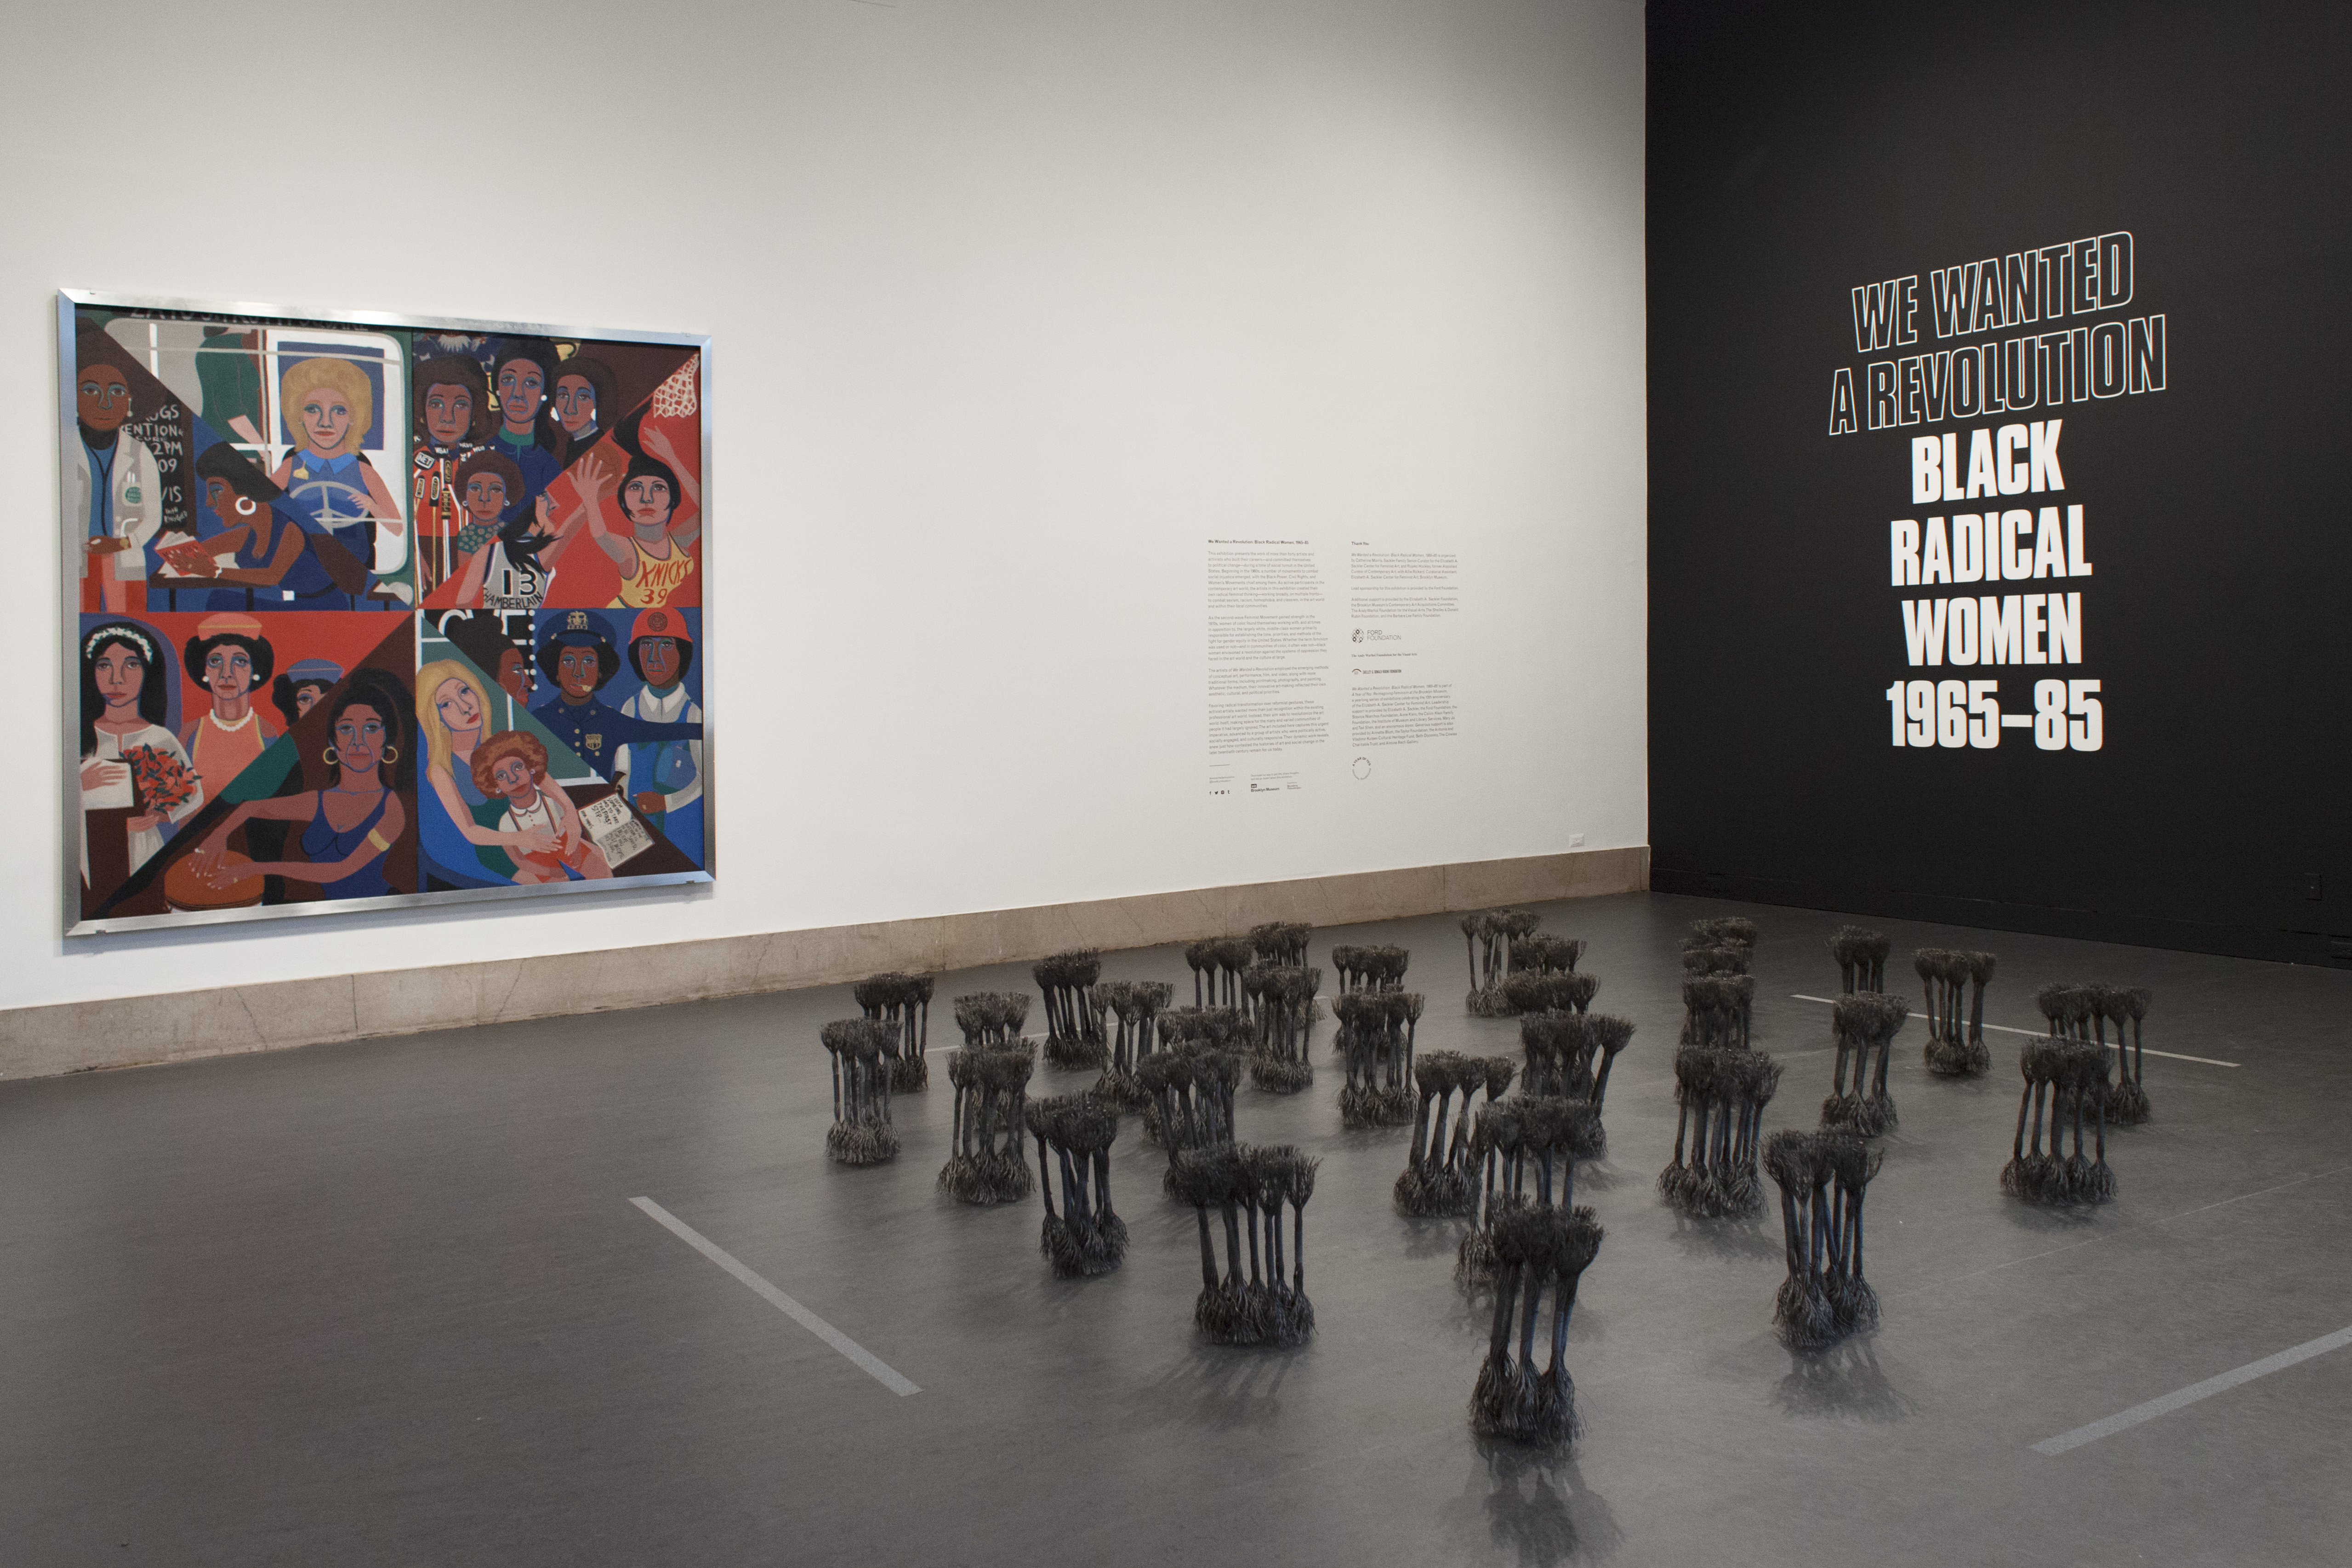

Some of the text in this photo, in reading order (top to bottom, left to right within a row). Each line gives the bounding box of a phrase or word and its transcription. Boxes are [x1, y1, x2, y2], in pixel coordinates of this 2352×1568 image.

[1851, 231, 2134, 353] WE WANTED
[1829, 314, 2166, 435] A REVOLUTION
[146, 404, 180, 422] UGS
[1912, 419, 2065, 504] BLACK
[635, 559, 692, 588] KNICKS
[1891, 504, 2092, 586] RADICAL
[502, 569, 537, 596] 13
[640, 589, 667, 604] 39
[1902, 592, 2082, 666] WOMEN
[1886, 679, 2102, 752] 1965–85
